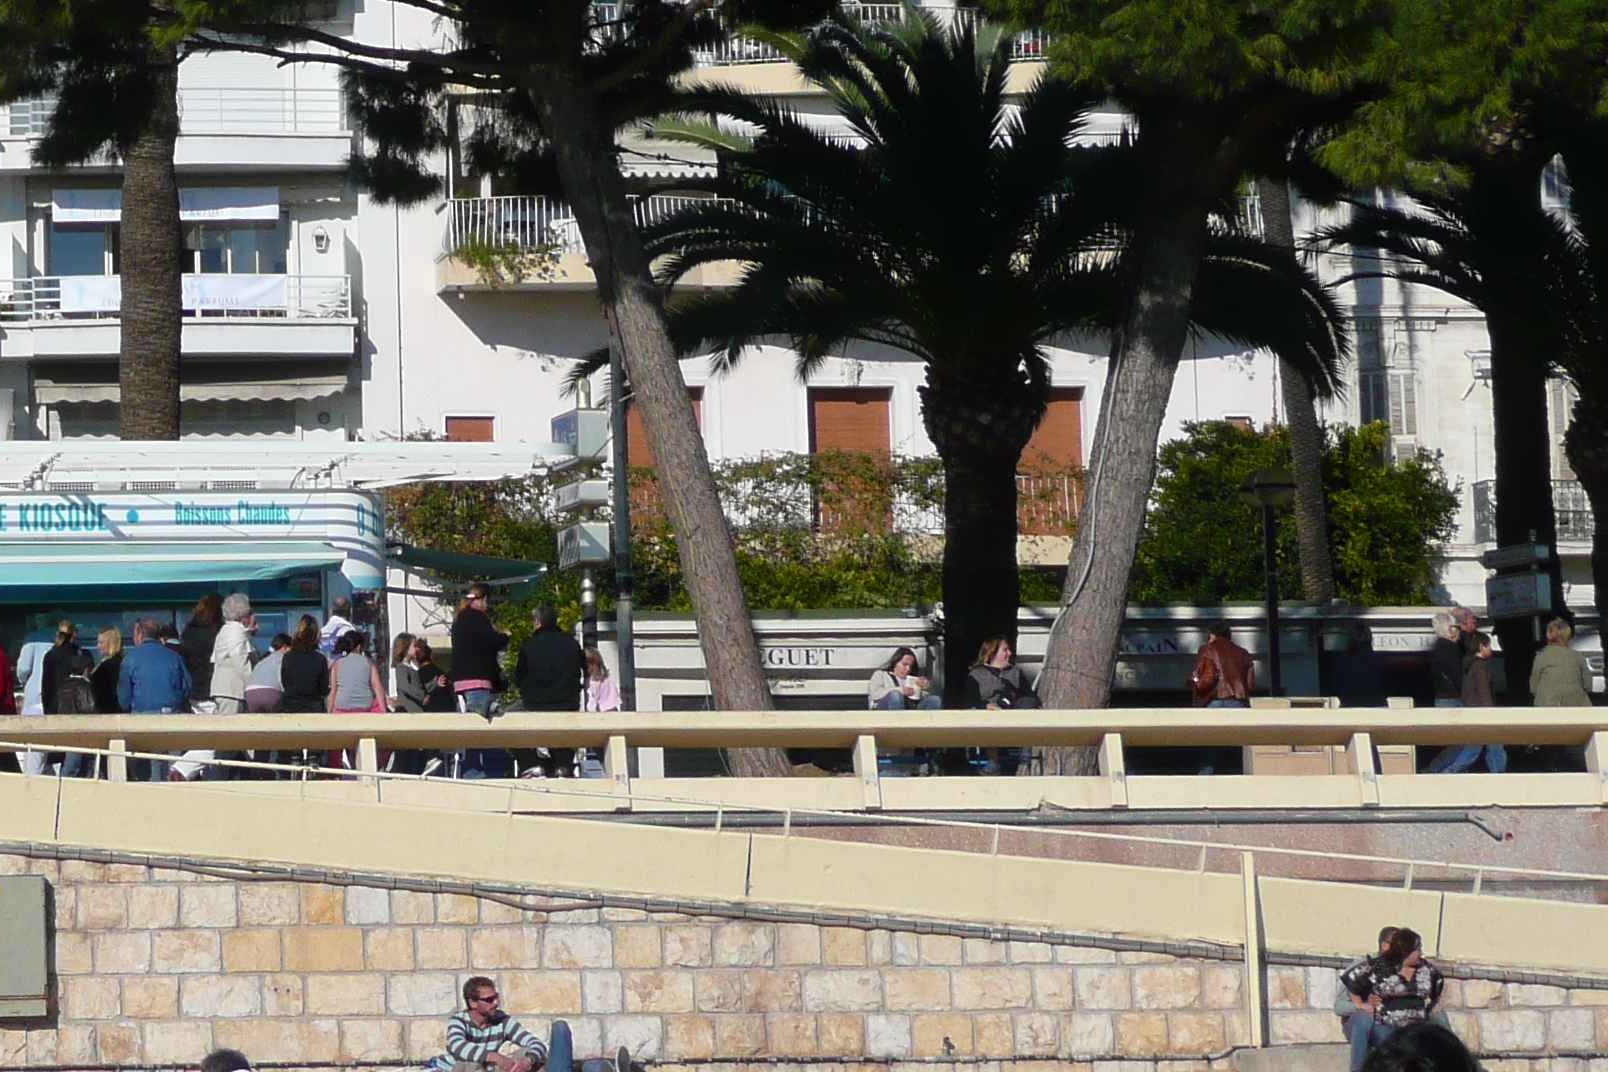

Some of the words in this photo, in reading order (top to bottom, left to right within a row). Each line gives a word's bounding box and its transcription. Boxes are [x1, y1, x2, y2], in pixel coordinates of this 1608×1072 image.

[191, 296, 240, 306] PARFUMS
[19, 502, 108, 532] KIOSQUE
[175, 501, 231, 526] Boissons
[237, 500, 291, 526] Chaudes
[759, 648, 835, 666] EGUET
